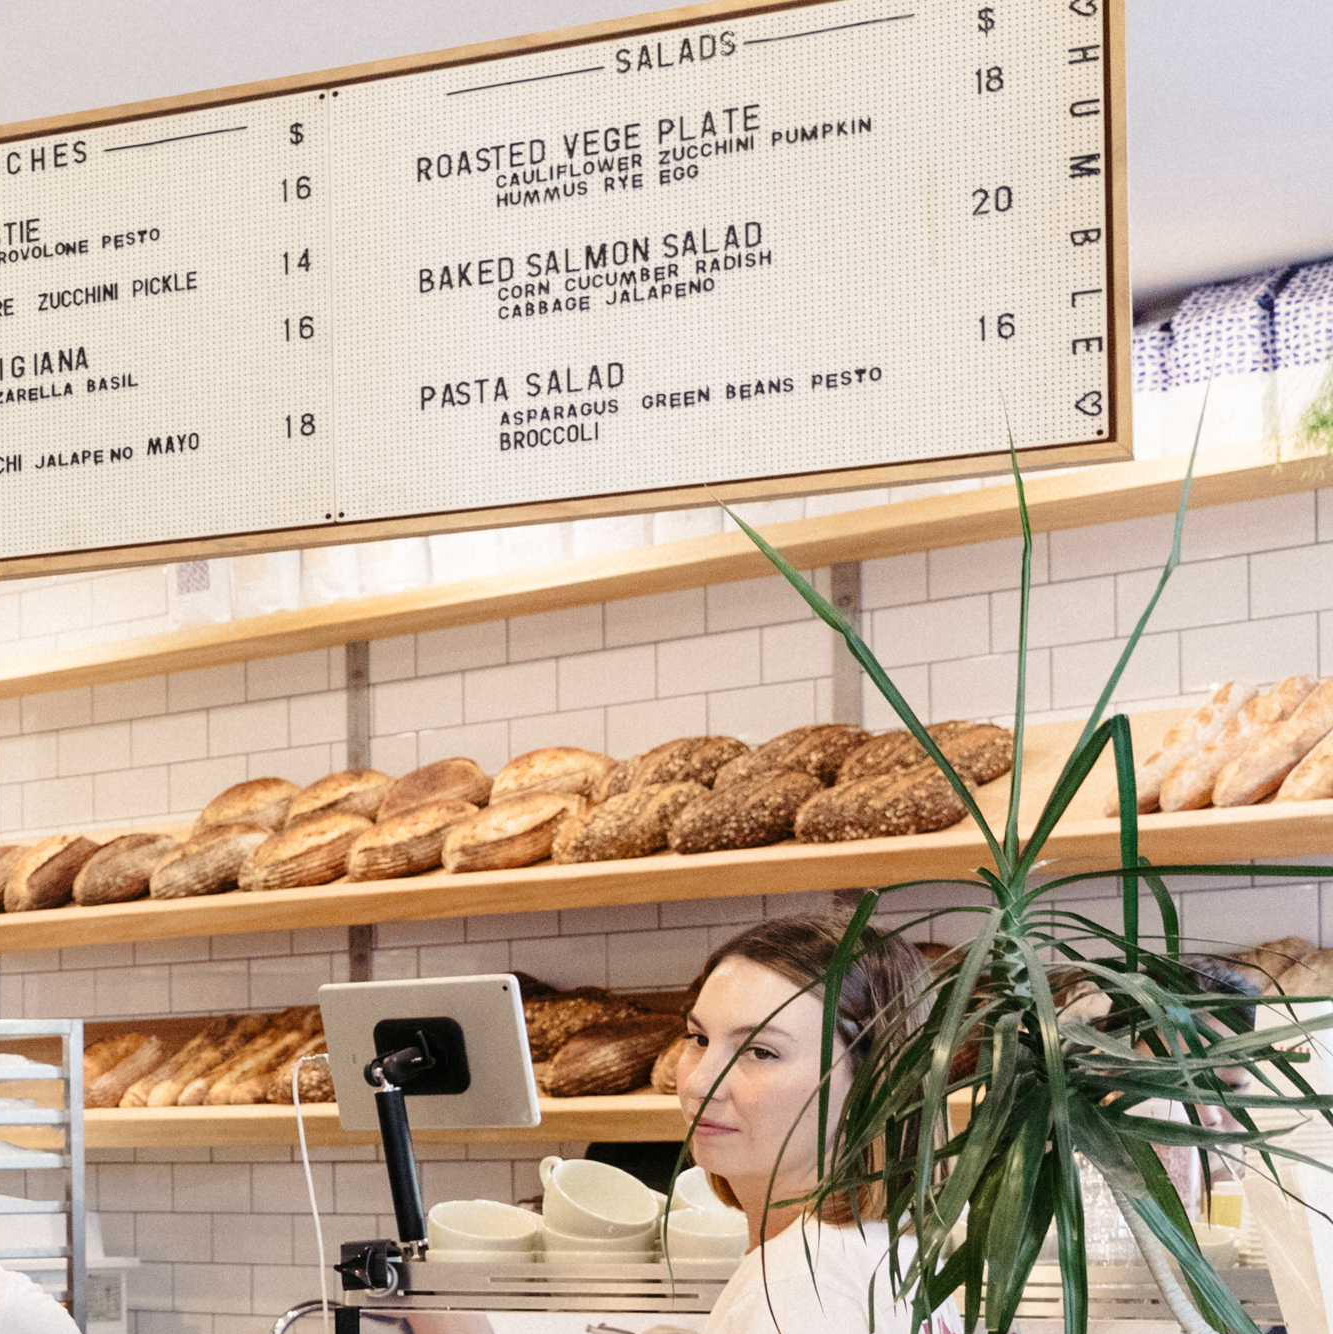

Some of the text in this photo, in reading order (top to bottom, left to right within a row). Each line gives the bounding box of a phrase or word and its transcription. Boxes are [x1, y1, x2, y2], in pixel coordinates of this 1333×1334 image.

[616, 7, 995, 74] SALADS $
[290, 122, 304, 146] $
[417, 66, 1004, 182] ROASTED VEGE PLATE 18
[496, 118, 872, 188] CAULIFLOWER ZUCCHINI PUMPKIN
[282, 175, 311, 202] 16
[496, 164, 699, 207] HUMMUS RYE EGG
[102, 228, 160, 250] PESTO
[419, 185, 1013, 294] BAKED SALMON SALAD 20
[38, 283, 118, 312] ZUCCHINI
[132, 271, 197, 297] PICKLE
[283, 248, 311, 275] 14
[498, 250, 772, 301] CORN CUCUMBER RADISH
[498, 277, 715, 320] CABBAGE JALAPENO
[284, 315, 314, 341] 16
[420, 312, 1015, 410] PASTA SALAD 16
[87, 374, 138, 393] BASIL
[500, 367, 882, 425] ASPARAGUS GREEN BEANS PESTO
[147, 432, 199, 455] MAYO
[286, 413, 316, 438] 18
[500, 422, 599, 451] BROCCOLI
